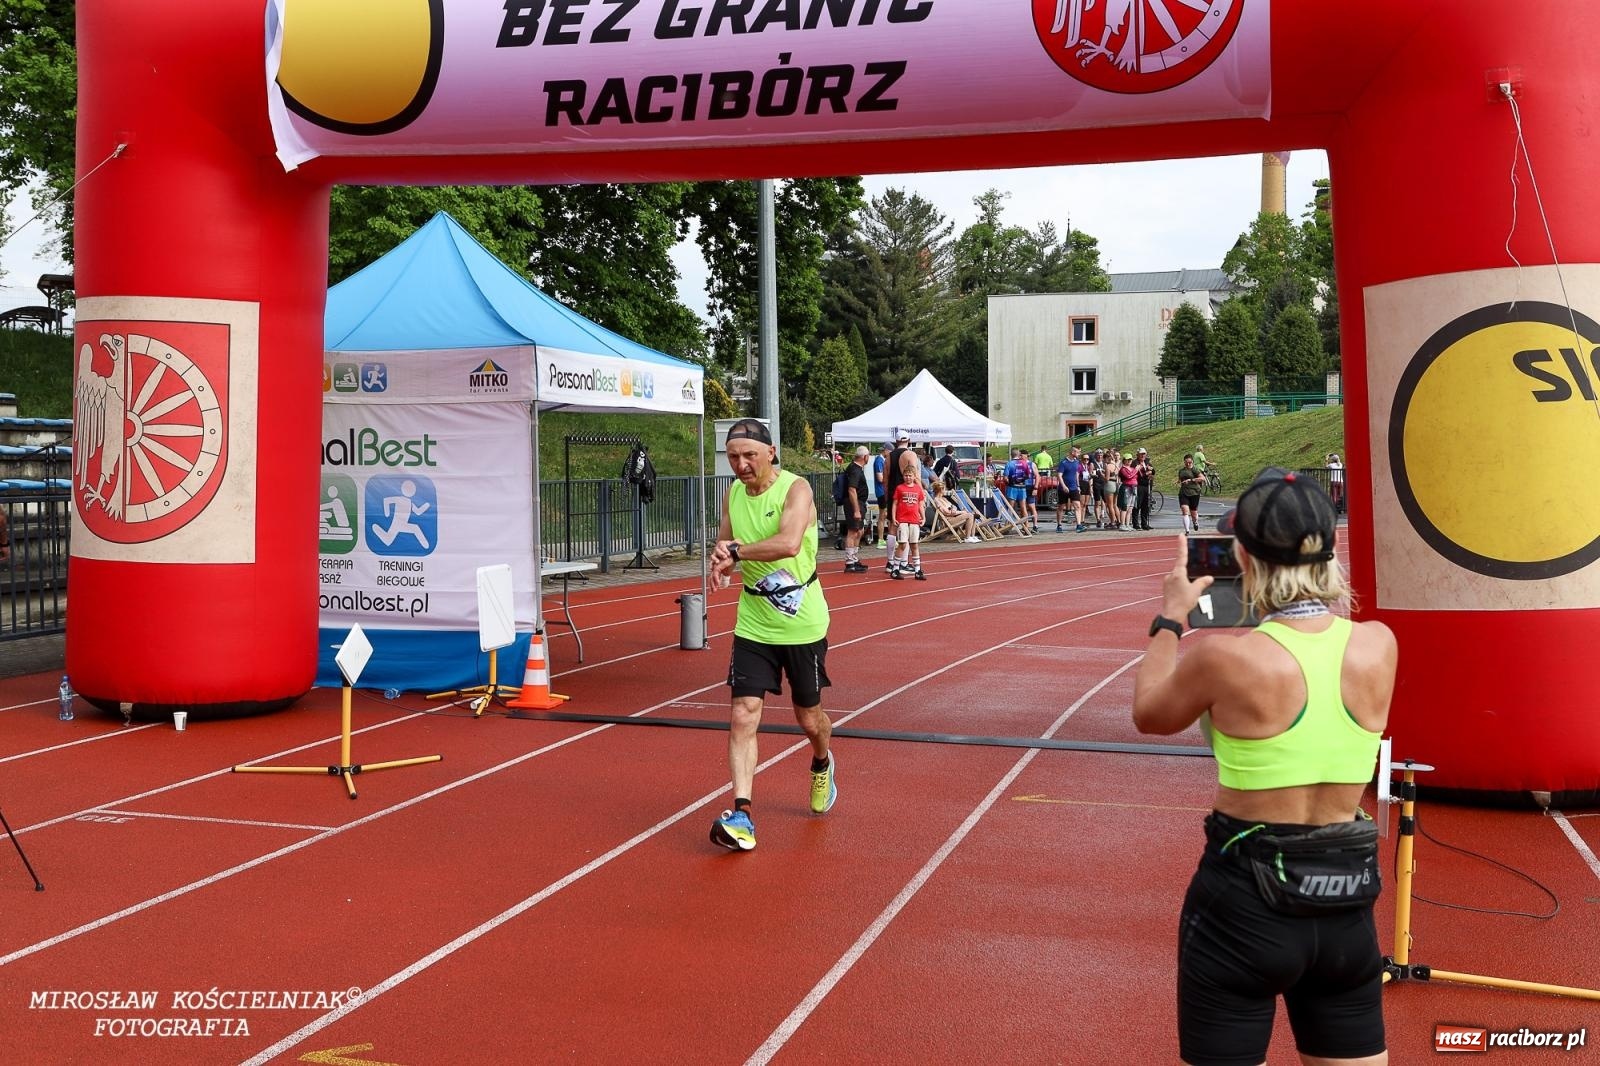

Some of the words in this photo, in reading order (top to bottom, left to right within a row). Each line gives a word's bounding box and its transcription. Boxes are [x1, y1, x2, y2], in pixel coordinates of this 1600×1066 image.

[496, 0, 641, 47] BEZ
[543, 52, 907, 127] RACIBÓRZ
[469, 373, 509, 387] MITKO
[549, 362, 619, 393] PersonalBest
[1512, 346, 1600, 403] SI
[377, 575, 425, 587] BIEGOWE
[378, 560, 424, 572] TRENINGI
